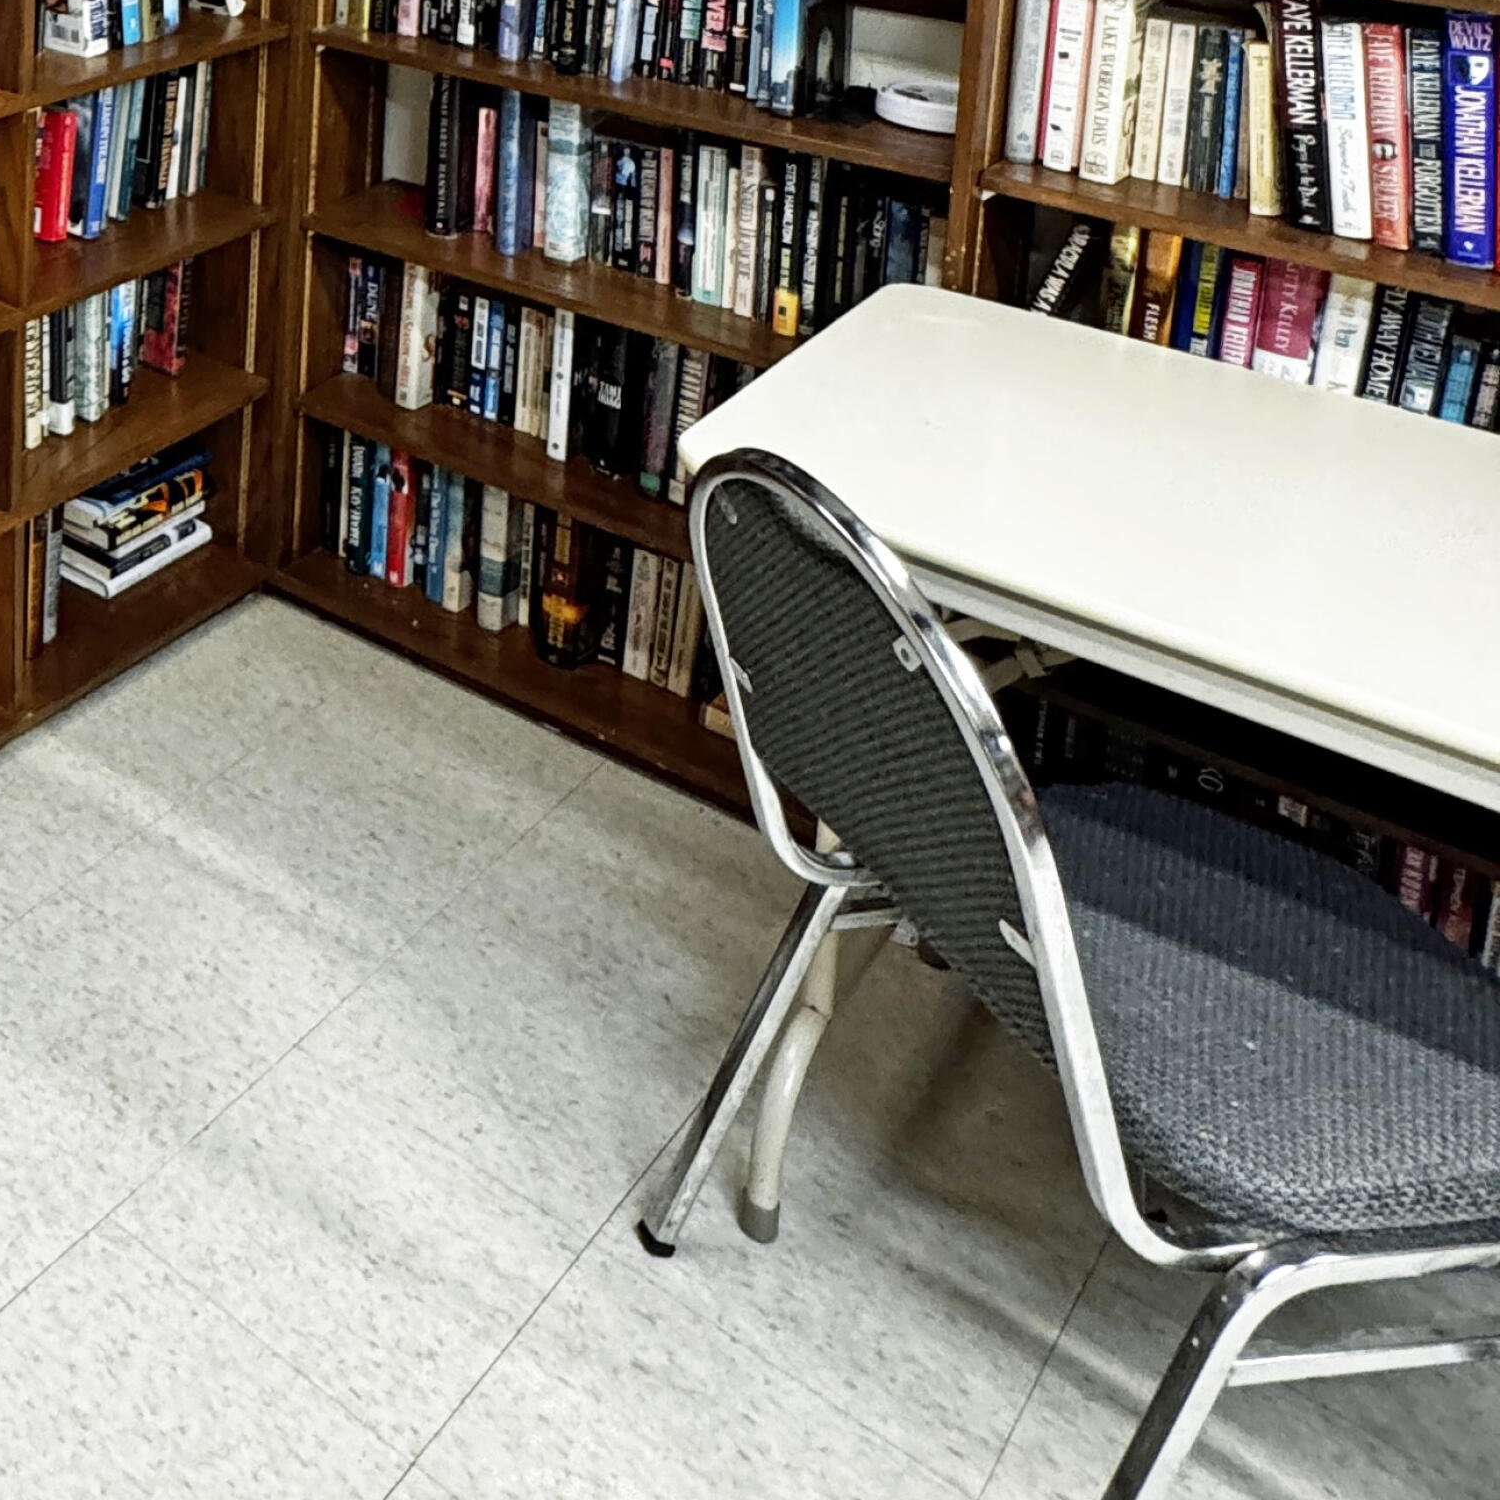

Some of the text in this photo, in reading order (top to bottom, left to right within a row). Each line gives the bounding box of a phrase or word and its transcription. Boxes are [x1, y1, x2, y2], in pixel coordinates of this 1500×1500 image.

[1101, 13, 1119, 52] LAKE
[1449, 20, 1494, 36] DEVIL'S
[1450, 33, 1494, 51] WALTZ
[1284, 35, 1318, 125] KELLERMAN
[1092, 119, 1109, 148] DAYS
[1454, 86, 1488, 235] JONATHAN KELLERMAN
[1373, 164, 1400, 221] STALKER
[1414, 160, 1443, 235] FORGOTTEN
[1142, 303, 1162, 341] FLESH
[1273, 302, 1300, 353] KELLEY
